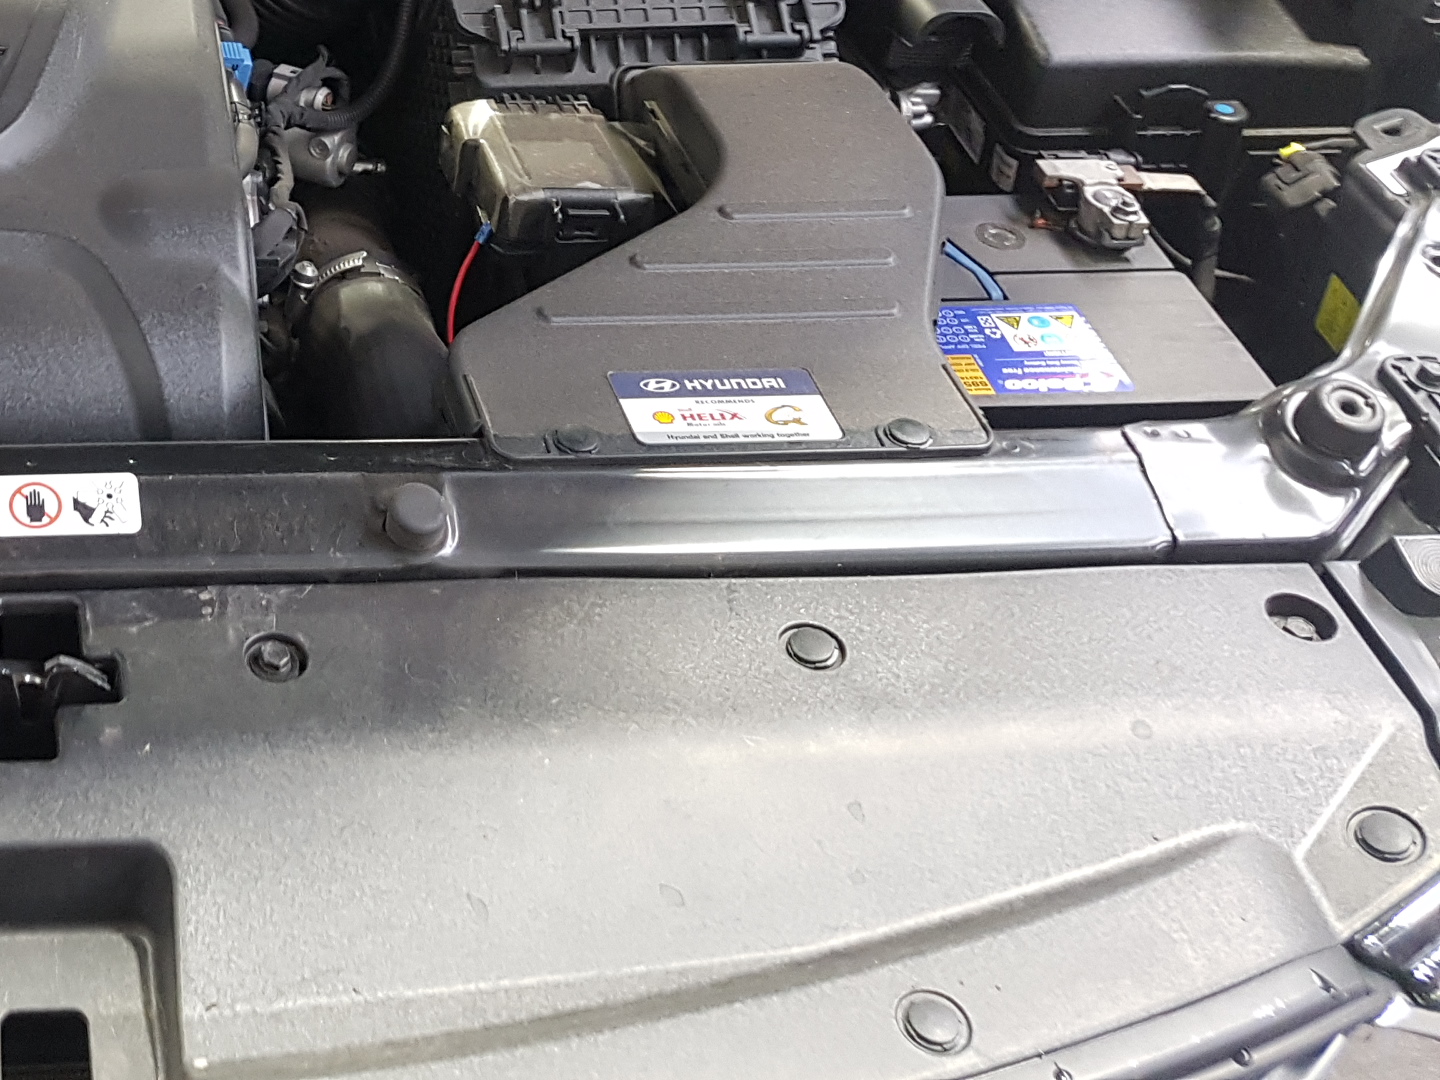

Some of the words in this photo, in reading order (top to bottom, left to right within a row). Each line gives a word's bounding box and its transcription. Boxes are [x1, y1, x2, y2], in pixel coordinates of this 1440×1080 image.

[685, 377, 786, 391] HYUNDAI
[680, 411, 744, 421] HELIX
[667, 433, 702, 441] Hyundai
[742, 432, 775, 440] working
[776, 431, 811, 440] together
